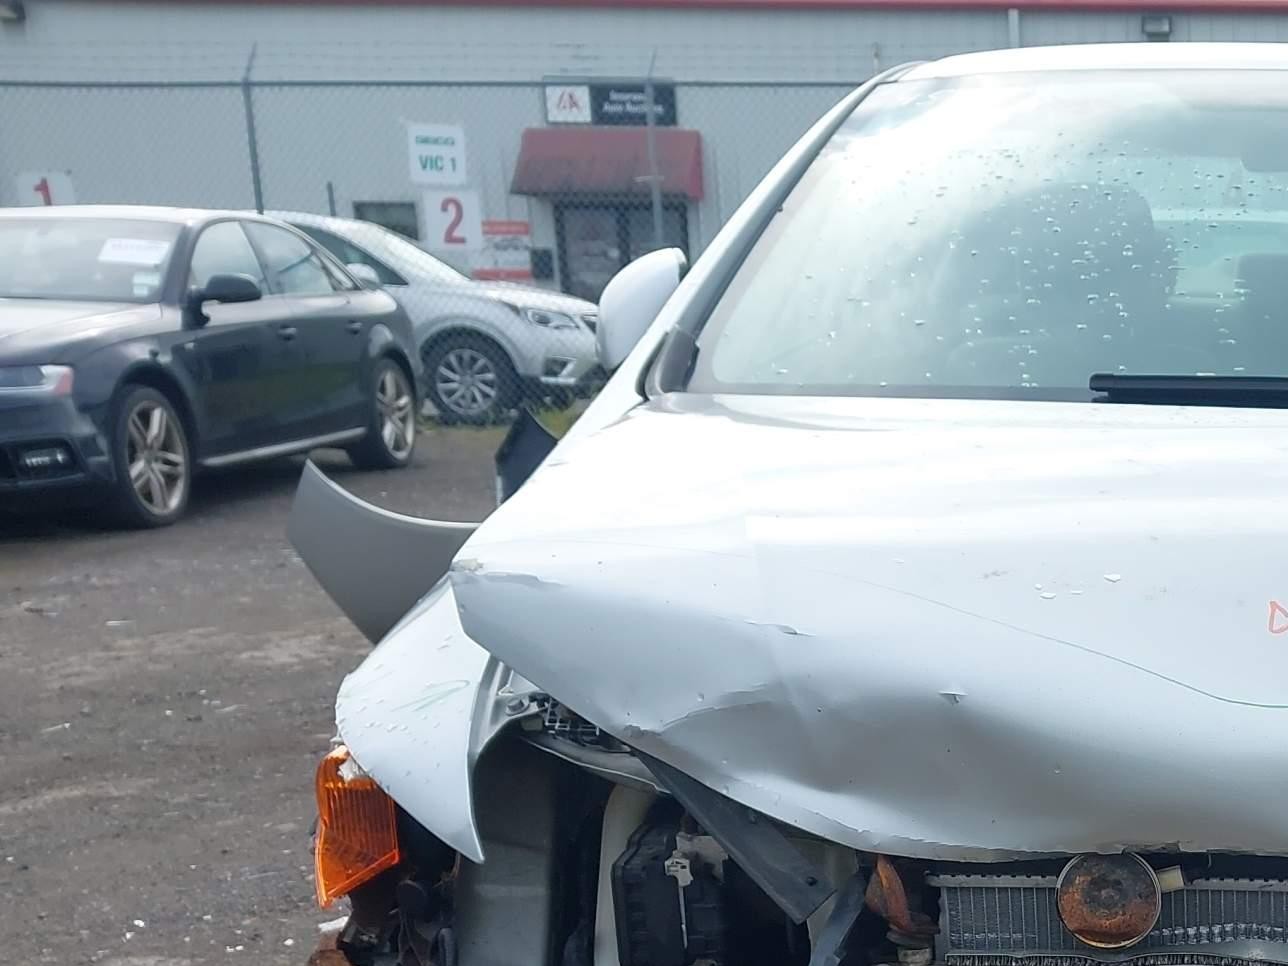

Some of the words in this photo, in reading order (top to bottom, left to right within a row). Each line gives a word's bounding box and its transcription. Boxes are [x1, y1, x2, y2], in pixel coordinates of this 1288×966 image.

[418, 154, 445, 172] VIC
[449, 156, 457, 173] 1
[440, 197, 467, 244] 2
